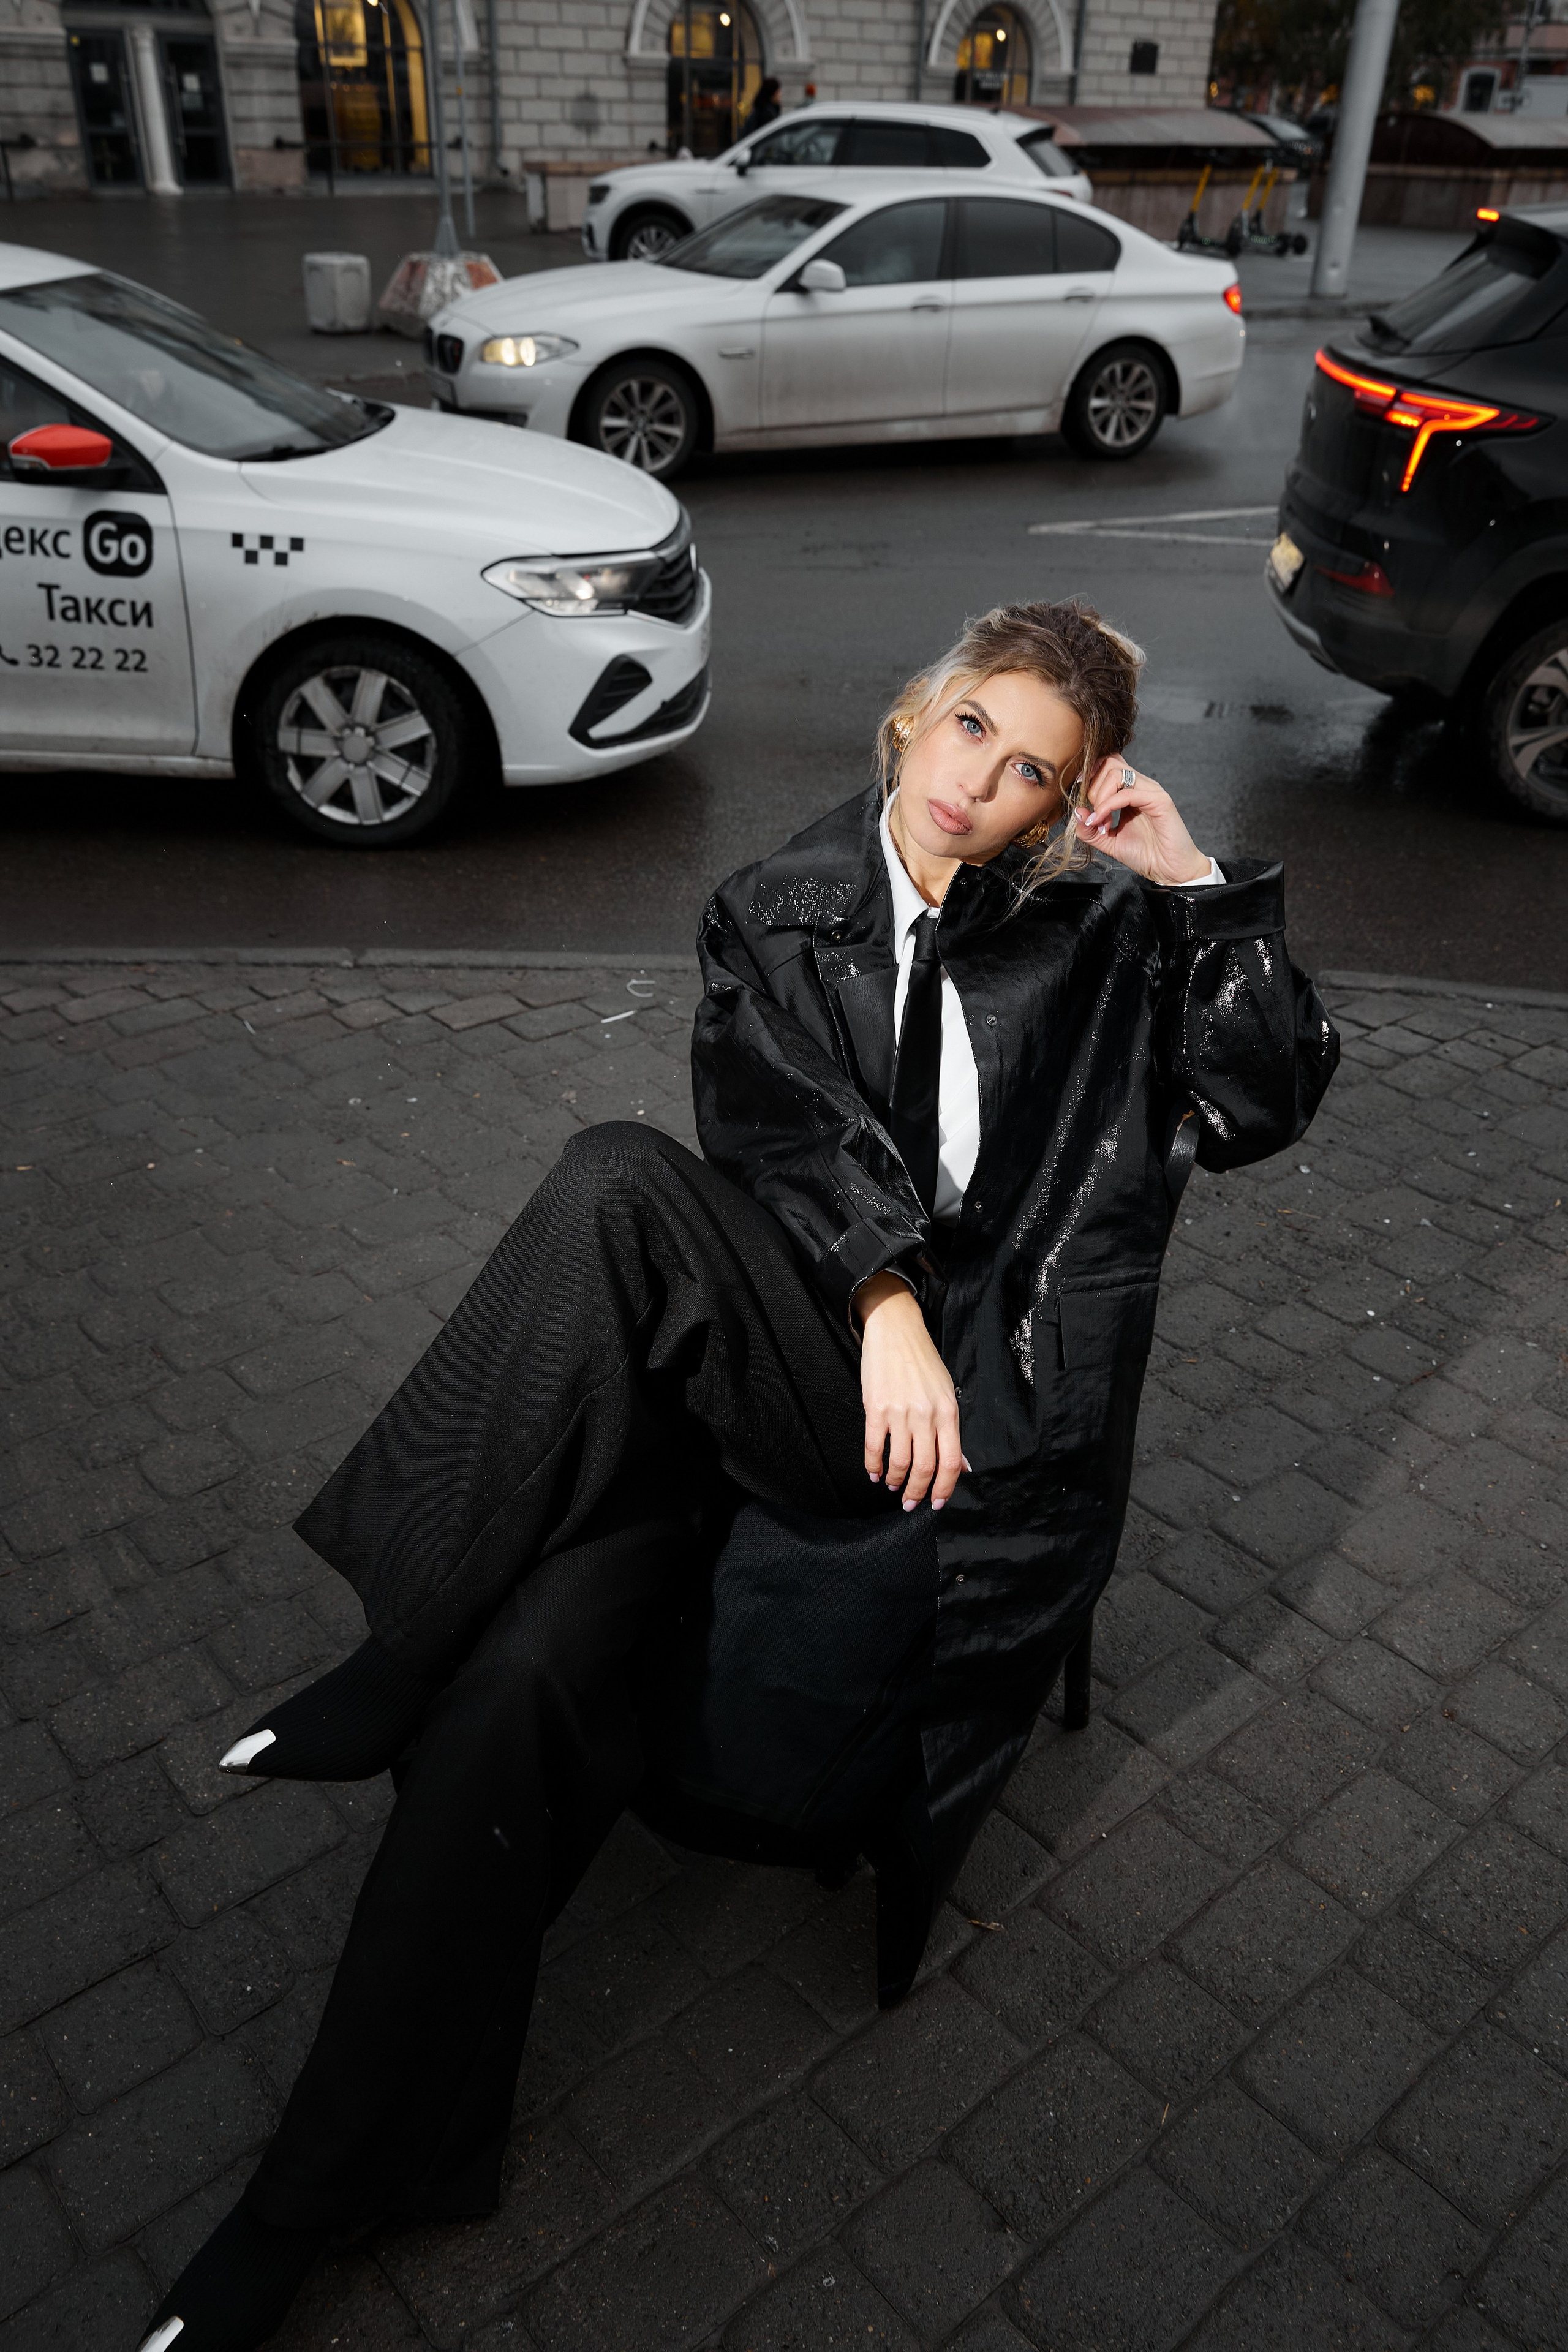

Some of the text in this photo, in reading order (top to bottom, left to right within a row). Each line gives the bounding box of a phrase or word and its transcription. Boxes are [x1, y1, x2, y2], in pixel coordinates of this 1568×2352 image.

[0, 521, 147, 566] екс Go
[37, 582, 153, 628] Такси
[27, 643, 148, 673] 32 22 22
